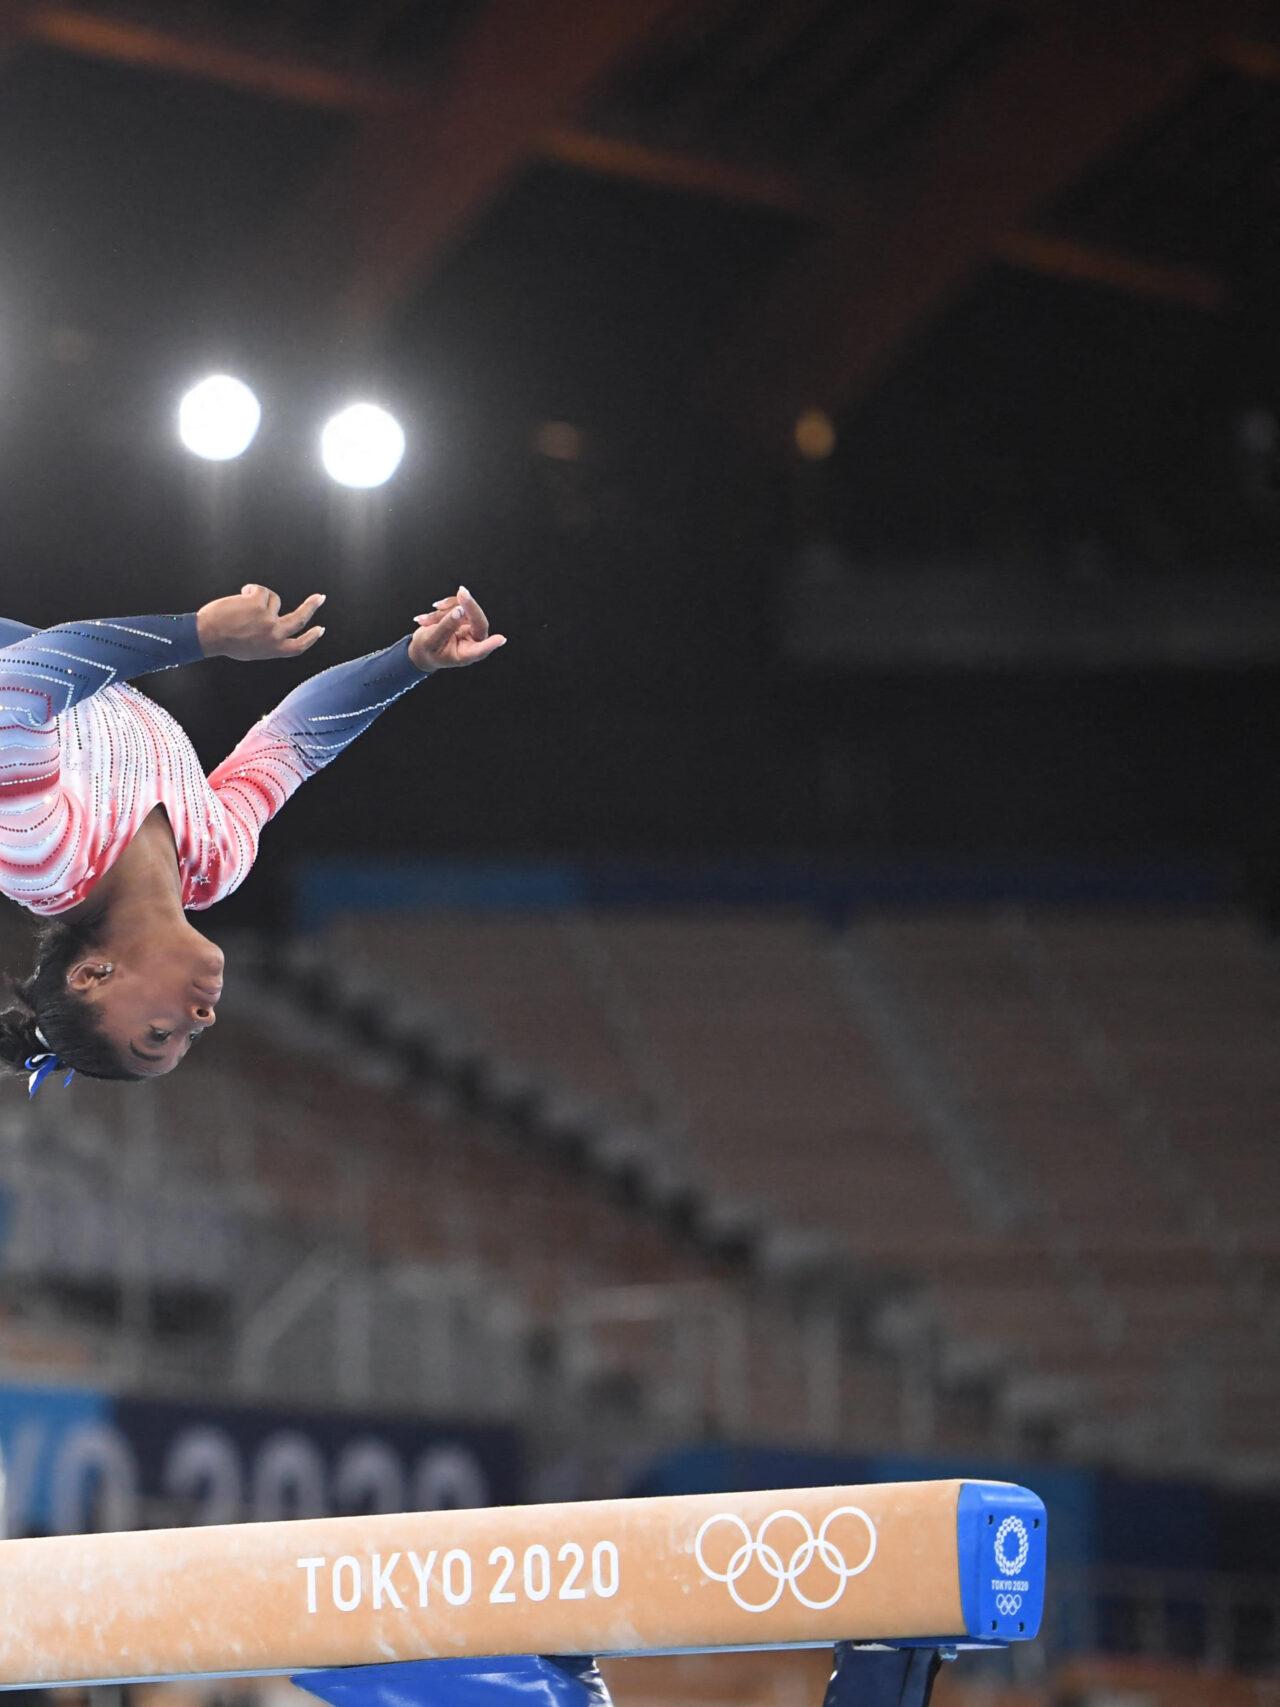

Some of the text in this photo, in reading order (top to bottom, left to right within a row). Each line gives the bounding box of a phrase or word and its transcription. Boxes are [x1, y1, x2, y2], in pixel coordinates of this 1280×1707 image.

[296, 1540, 619, 1613] TOKYO 2020
[991, 1579, 1029, 1592] TOKYO 2020
